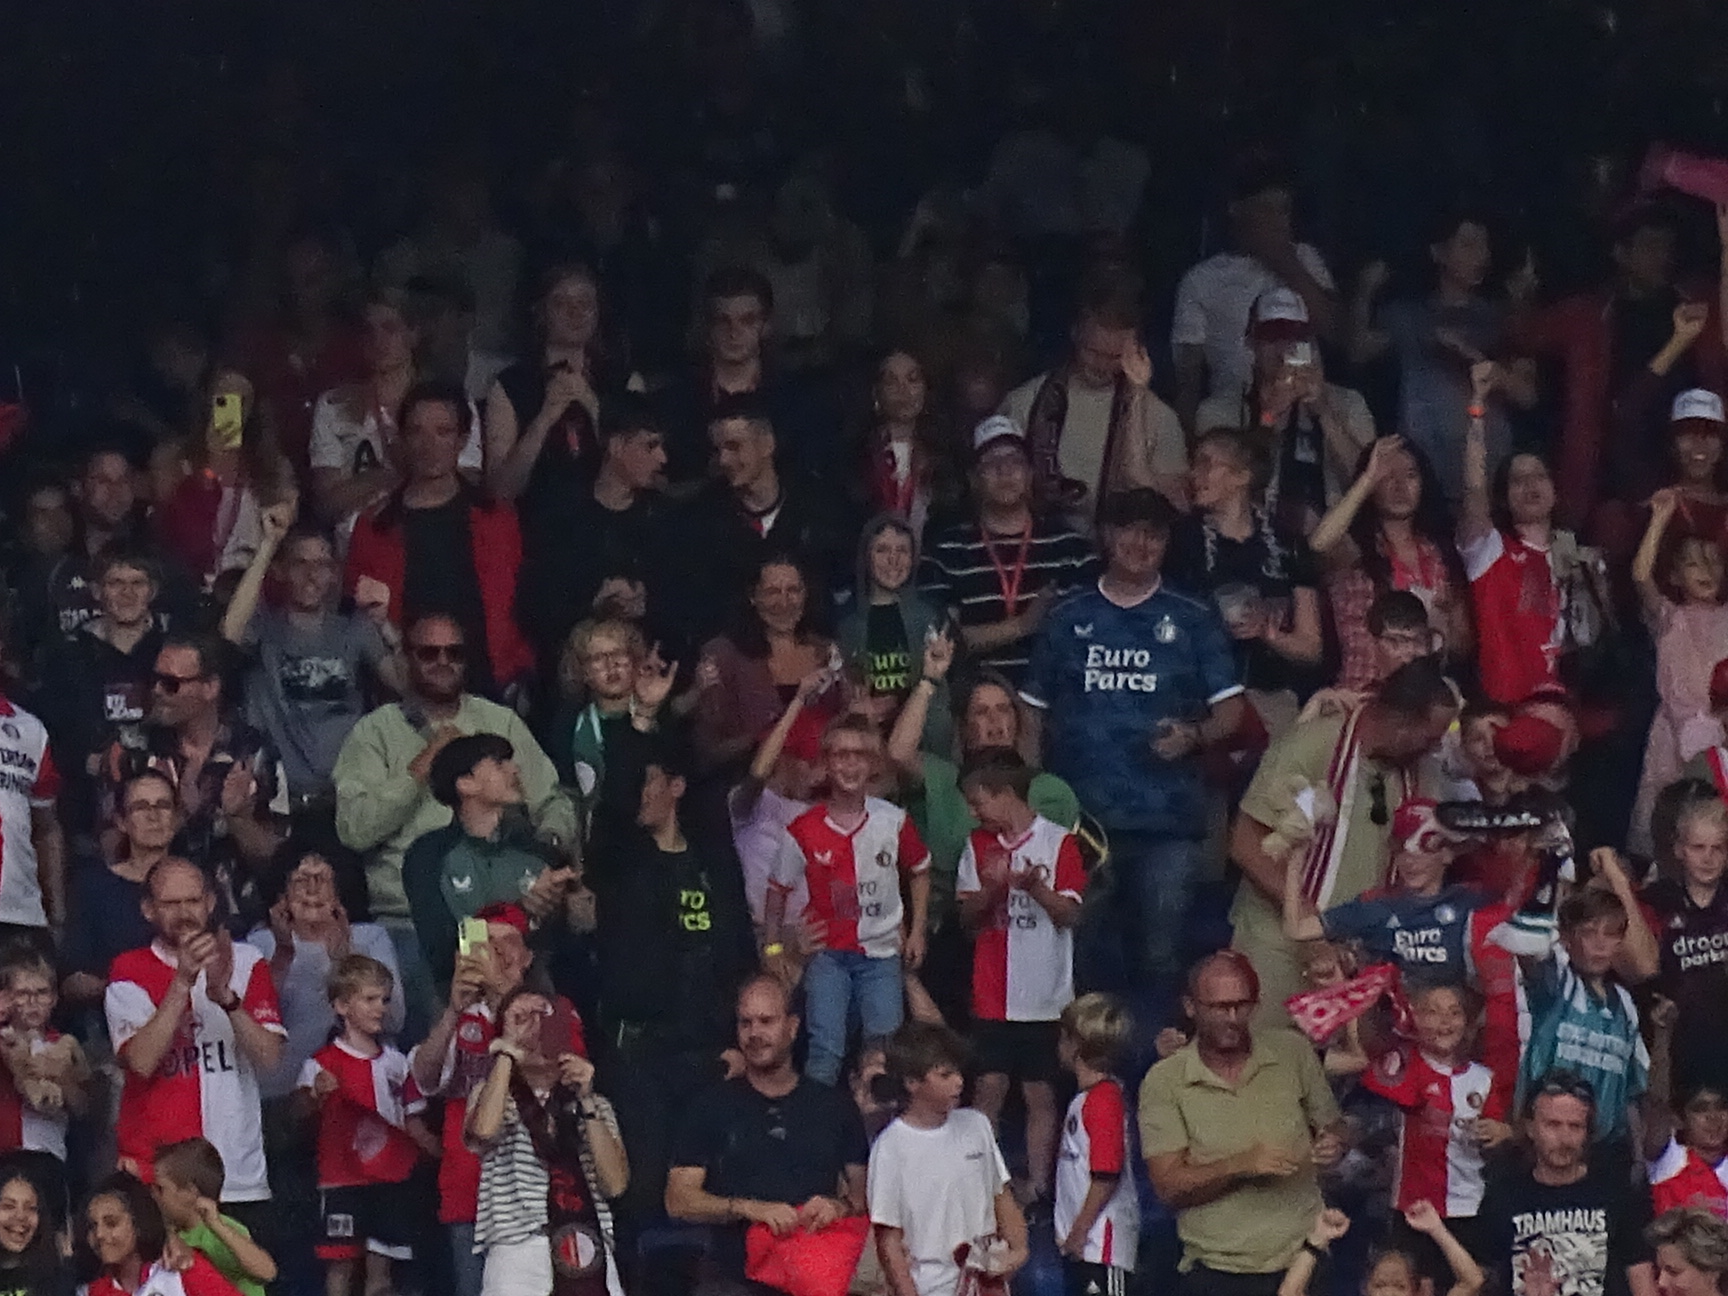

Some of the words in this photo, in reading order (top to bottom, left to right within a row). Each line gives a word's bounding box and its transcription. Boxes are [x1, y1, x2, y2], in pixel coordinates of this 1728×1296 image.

[873, 653, 910, 672] uro
[1085, 643, 1151, 669] Euro
[1084, 669, 1159, 693] Parcs
[164, 1039, 232, 1077] OPEL
[1512, 1209, 1607, 1235] TRAMHAUS
